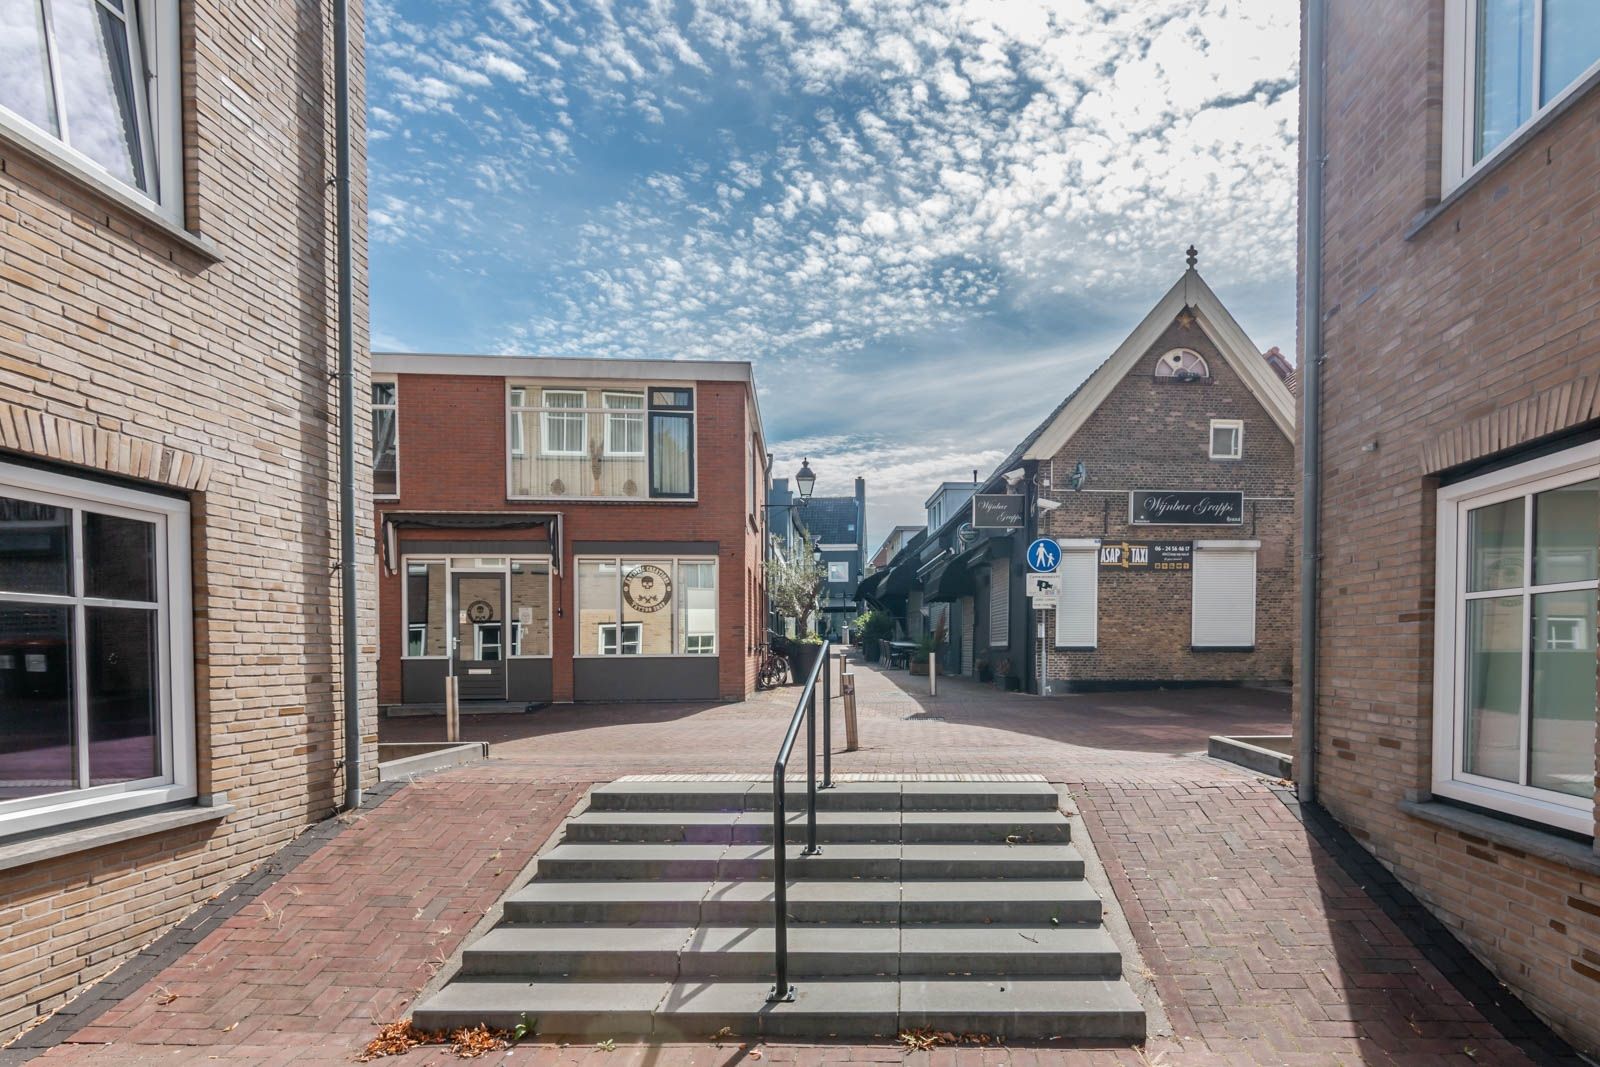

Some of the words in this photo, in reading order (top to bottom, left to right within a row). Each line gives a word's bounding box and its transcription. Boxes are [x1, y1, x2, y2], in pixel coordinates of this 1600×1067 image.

[1143, 494, 1190, 516] Wijnbar
[1192, 496, 1234, 517] Grapps
[1100, 548, 1121, 563] ASAP
[1131, 548, 1148, 563] TAXI
